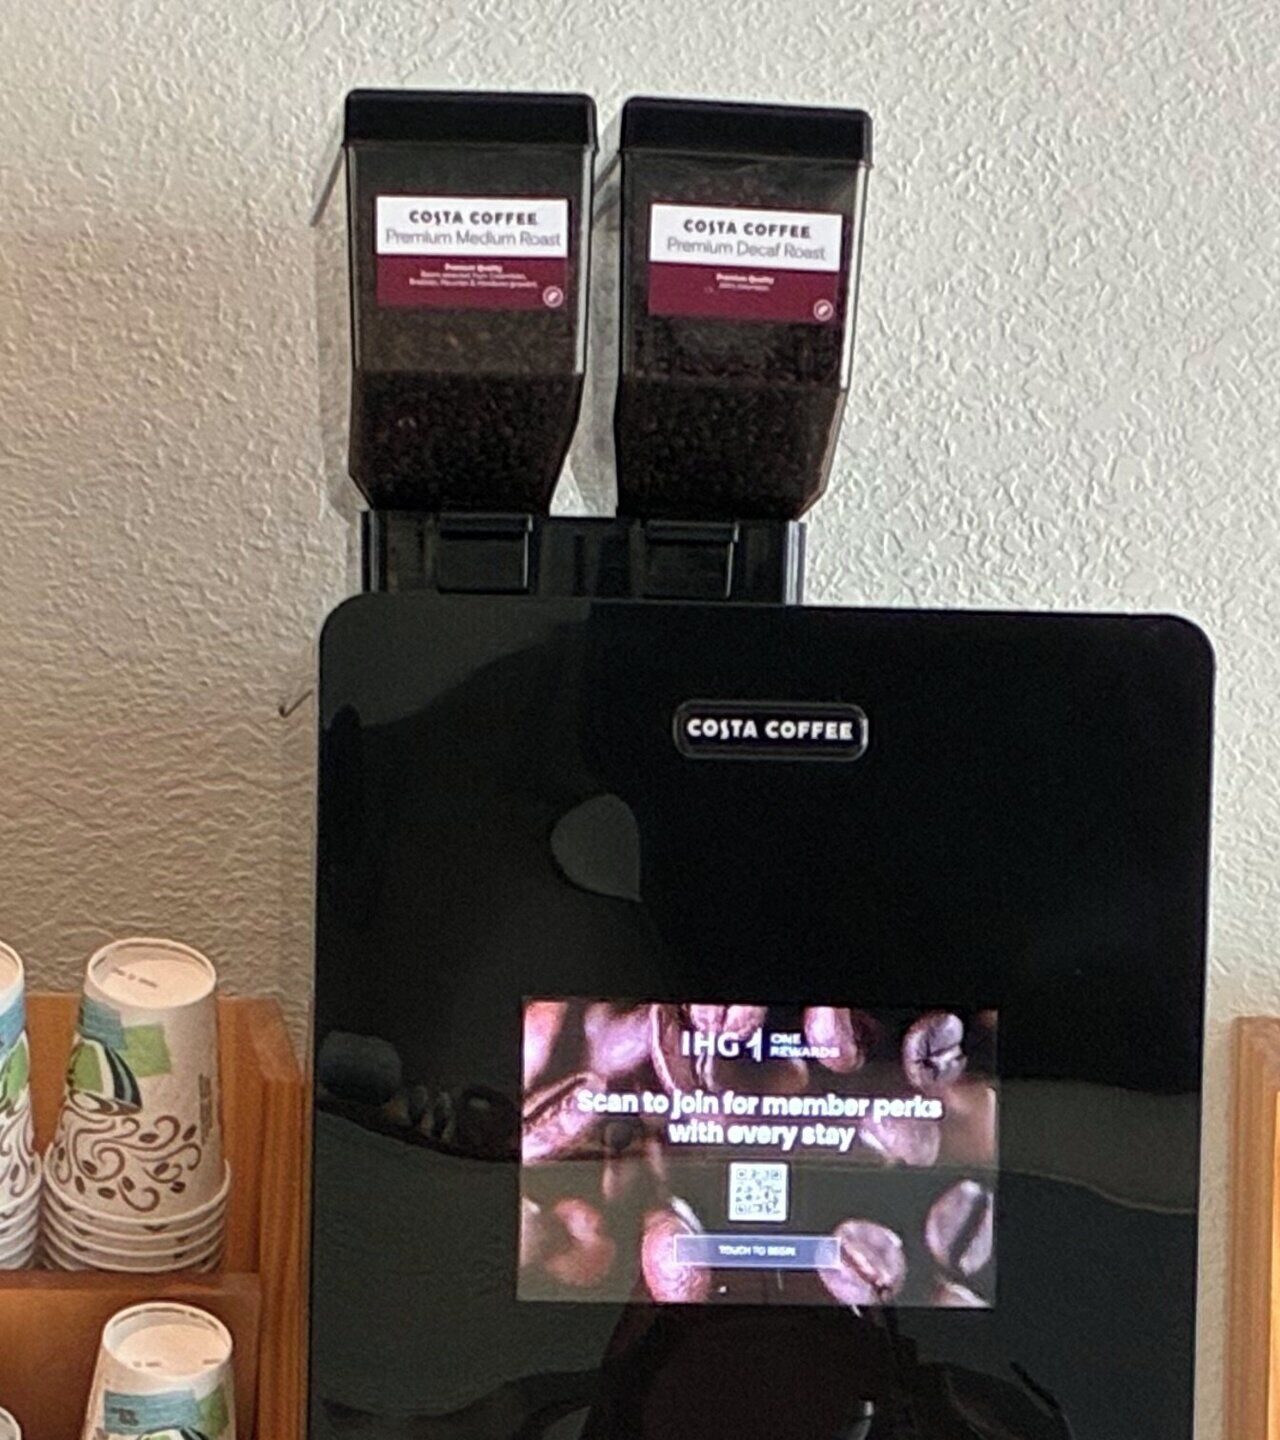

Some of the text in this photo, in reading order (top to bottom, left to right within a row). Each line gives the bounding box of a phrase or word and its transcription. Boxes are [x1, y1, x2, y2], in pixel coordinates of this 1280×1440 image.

[409, 210, 538, 226] COSTA COFFEE
[385, 228, 561, 246] Premium Medium Roast
[684, 219, 811, 238] COSTA COFFEE
[667, 236, 826, 260] Premium Decaf Roast
[686, 718, 854, 741] COSTA COFFEE
[682, 1030, 740, 1057] IHG
[770, 1033, 802, 1045] ONE
[770, 1046, 841, 1058] REWARDS
[577, 1088, 943, 1122] Scan to join for member perks
[668, 1119, 856, 1151] with every stay
[752, 1246, 766, 1256] TO
